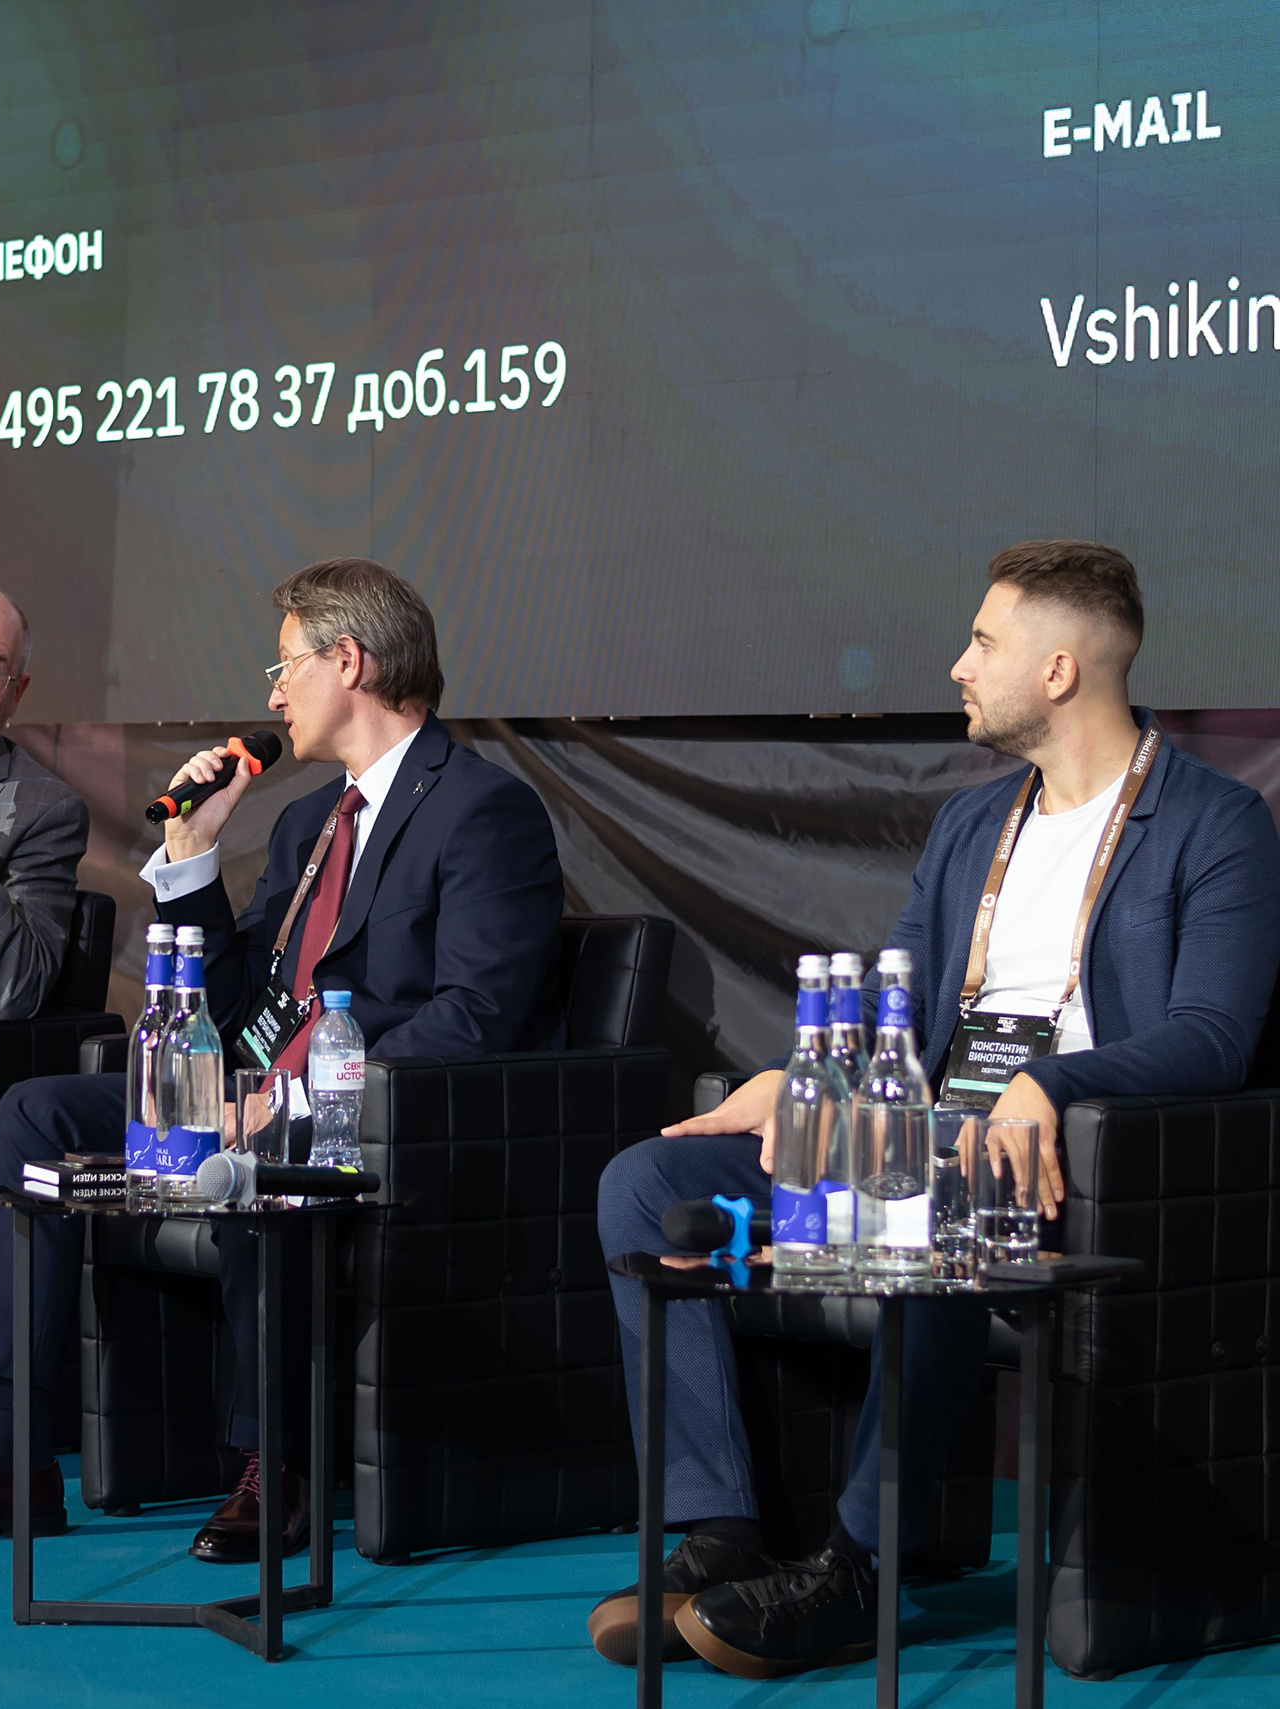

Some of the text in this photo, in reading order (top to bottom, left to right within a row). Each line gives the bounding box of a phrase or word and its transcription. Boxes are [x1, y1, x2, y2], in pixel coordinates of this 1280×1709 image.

[1043, 90, 1221, 158] E-MAIL
[1040, 276, 1280, 367] Vshikin
[96, 377, 185, 442] 221
[197, 368, 259, 434] 78
[272, 362, 335, 428] 37
[347, 341, 567, 433] доб.159
[1132, 727, 1158, 774] DEBTPRICE
[999, 808, 1022, 861] DEBTPRICE
[1107, 823, 1118, 845] TALK
[970, 1040, 1029, 1054] КОНСТАНТИН
[343, 1061, 365, 1071] СВЯТ
[72, 1173, 127, 1183] РСКИЕ ИДЕИ
[155, 1155, 174, 1167] EARL
